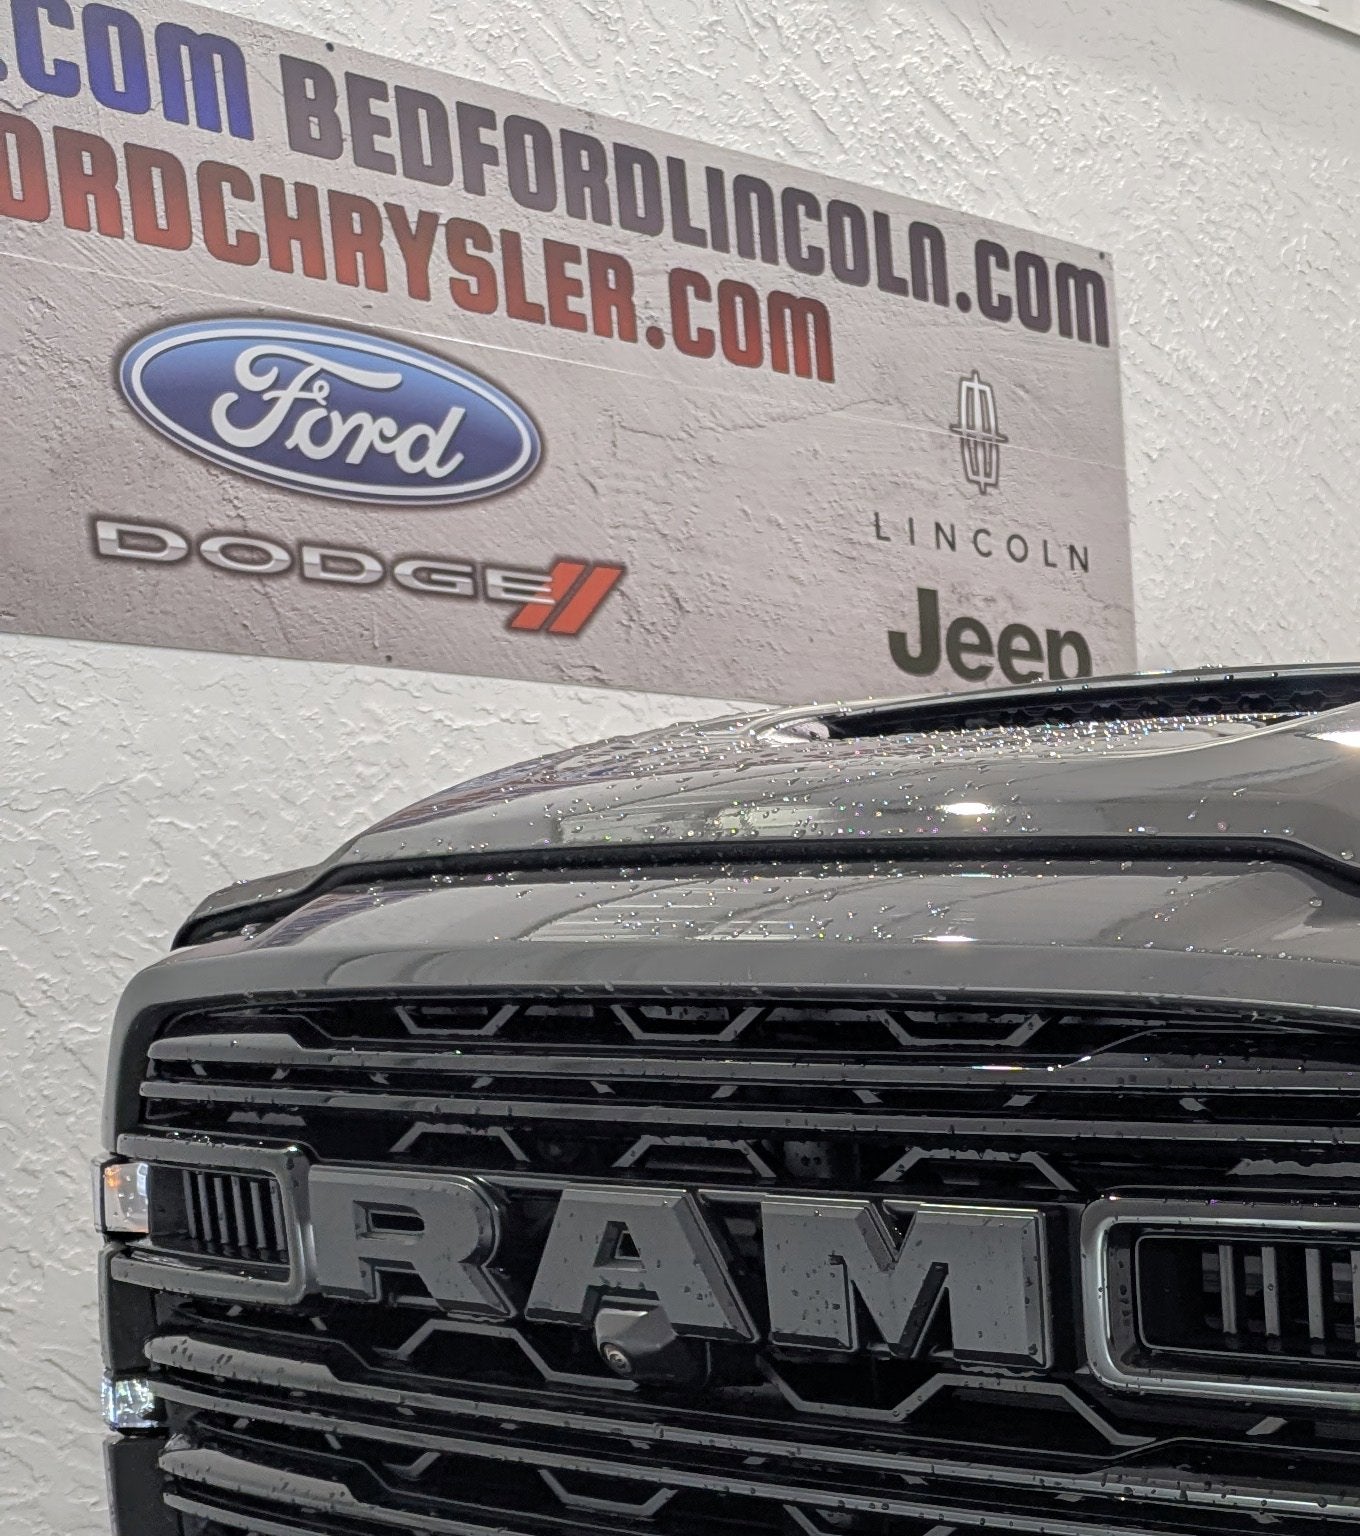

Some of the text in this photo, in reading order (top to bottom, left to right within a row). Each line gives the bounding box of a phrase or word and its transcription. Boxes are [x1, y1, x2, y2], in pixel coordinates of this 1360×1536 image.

[210, 342, 467, 481] Ford
[95, 519, 556, 606] DODGE
[874, 511, 1089, 574] LINCOLN
[887, 586, 1094, 685] Jeep
[305, 1163, 1059, 1372] RAM
